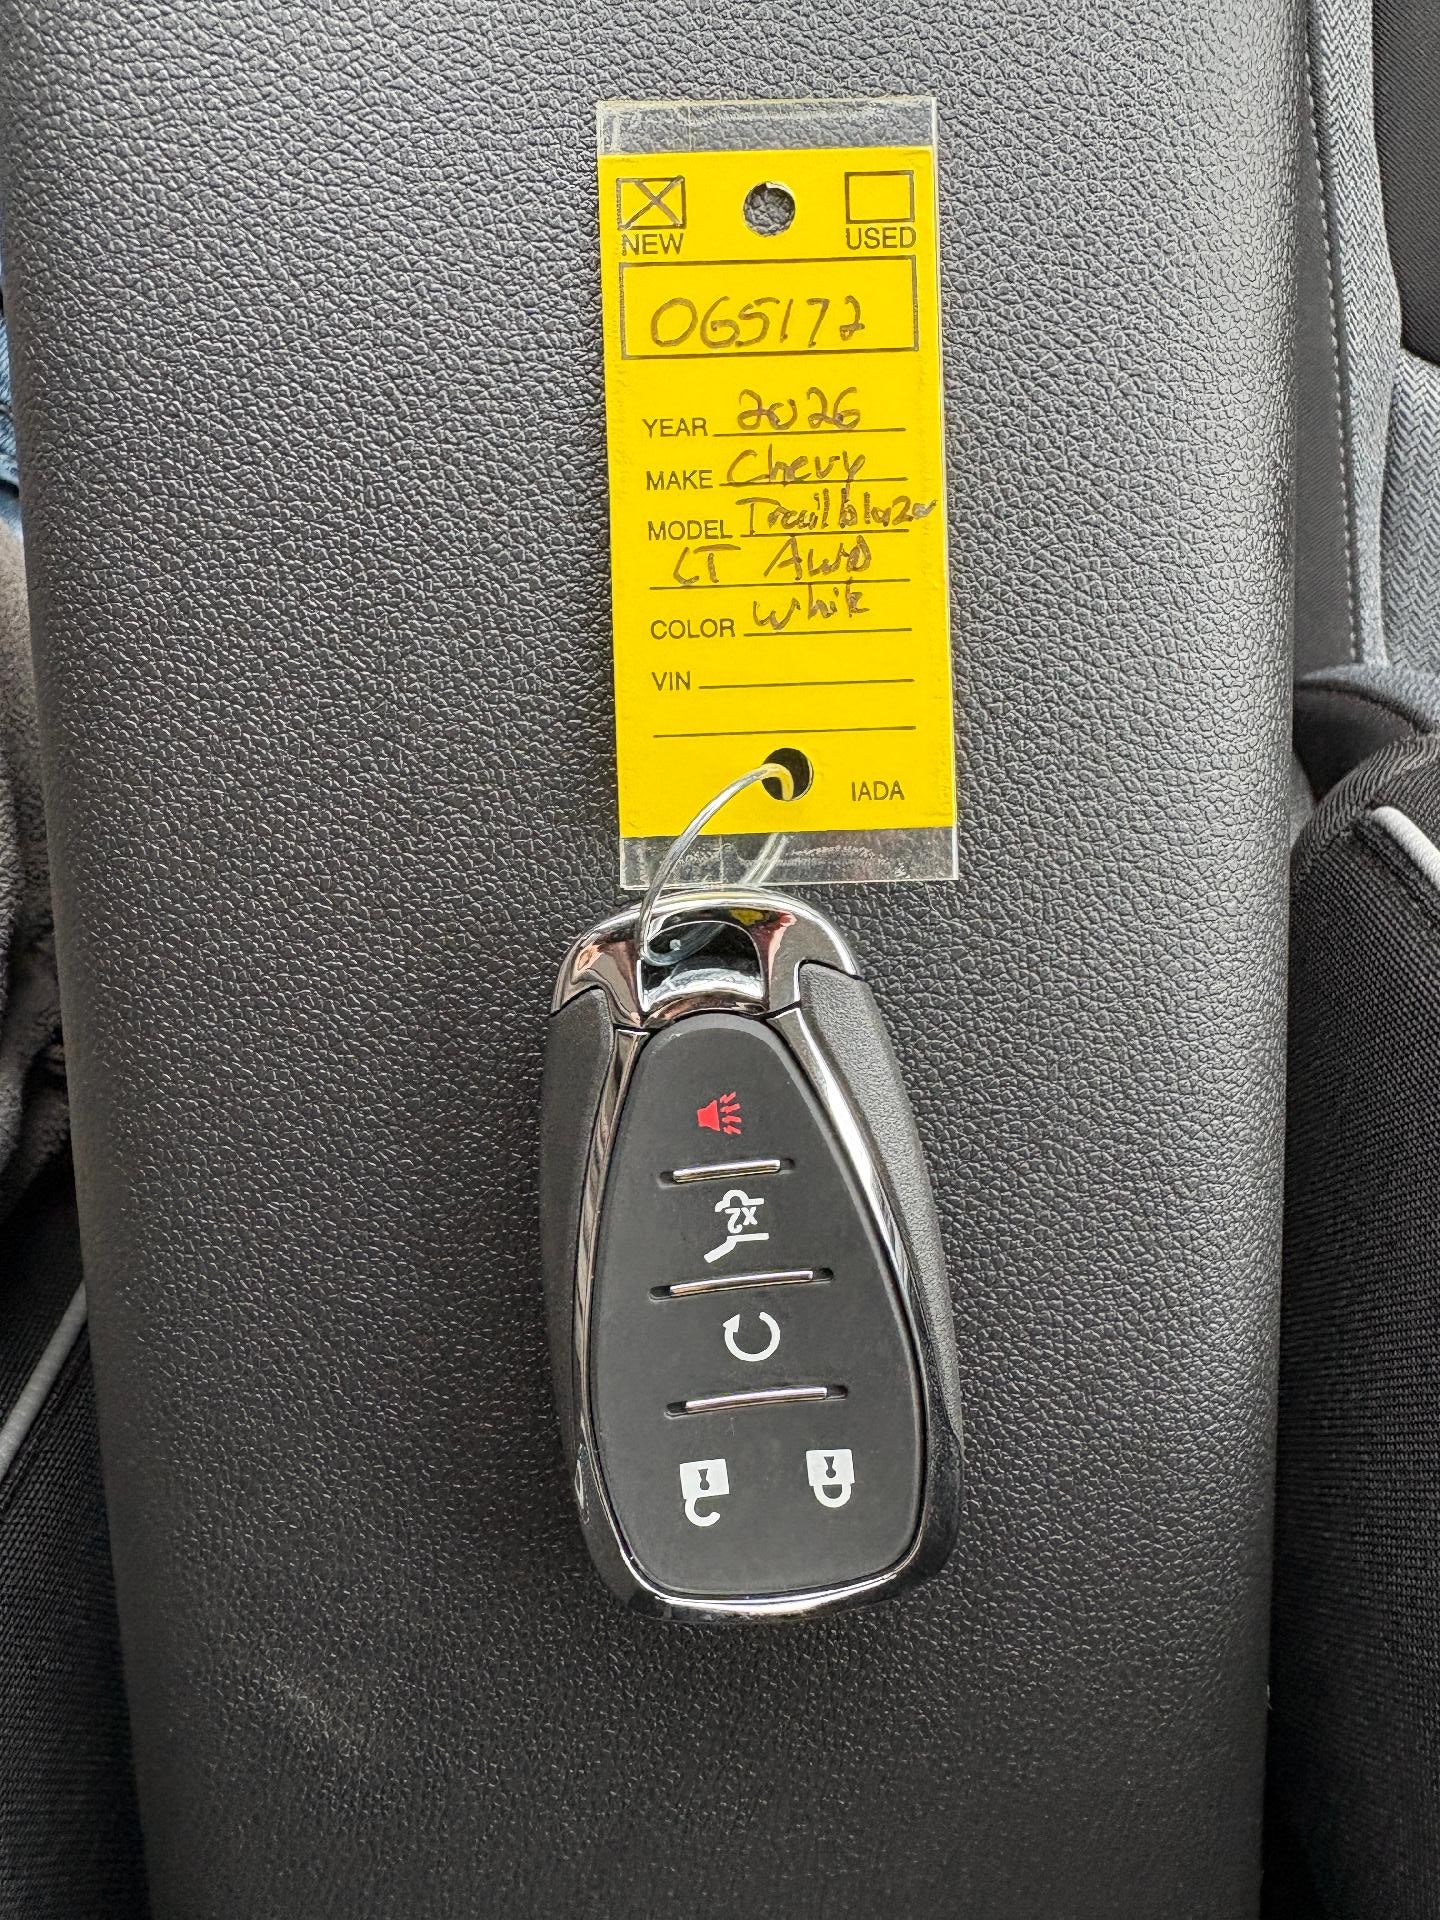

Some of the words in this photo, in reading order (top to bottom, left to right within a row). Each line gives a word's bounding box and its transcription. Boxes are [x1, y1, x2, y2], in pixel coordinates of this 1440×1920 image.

[621, 232, 684, 256] NEW
[845, 226, 917, 250] USED
[650, 295, 866, 349] 065172
[737, 386, 861, 431] 2026
[642, 417, 709, 438] YEAR
[726, 443, 866, 492] Chevy
[645, 469, 713, 491] MAKE
[647, 519, 733, 540] MODEL
[673, 544, 742, 585] LT
[763, 535, 872, 581] AWD
[650, 618, 735, 640] COLOR
[651, 671, 692, 691] VIN
[851, 780, 906, 802] IADA
